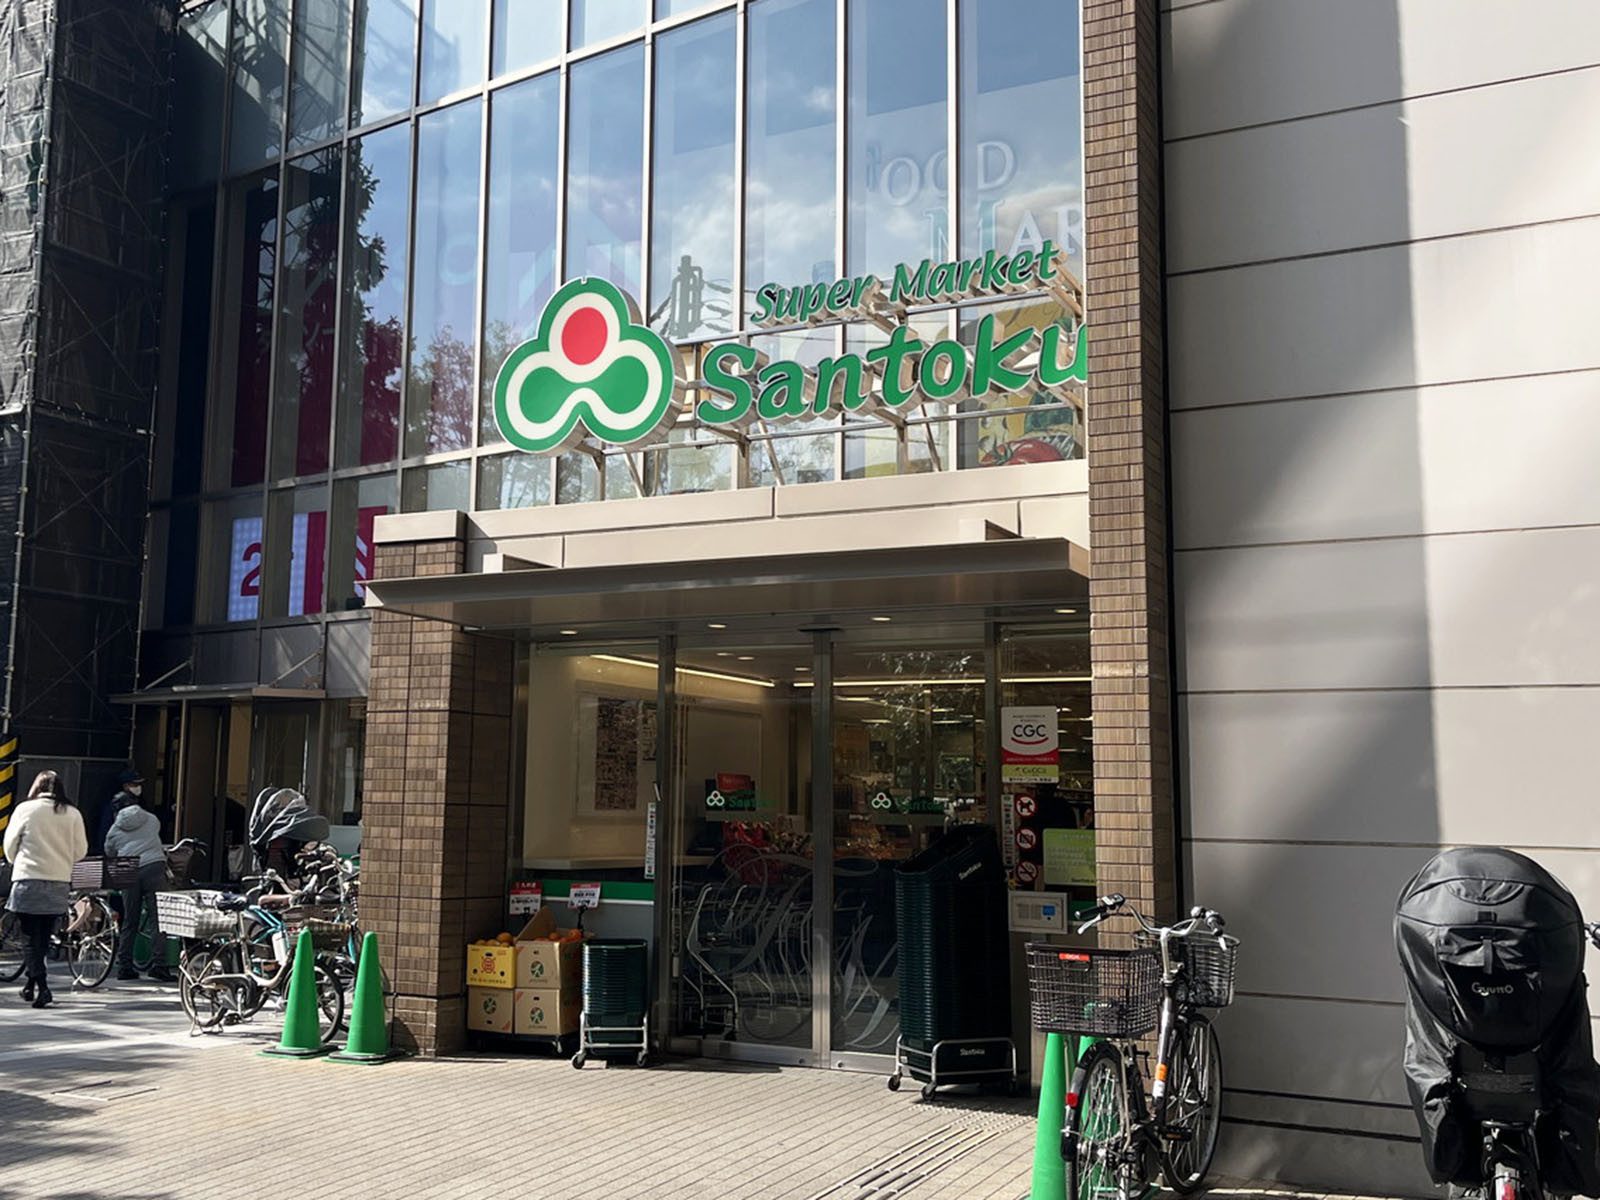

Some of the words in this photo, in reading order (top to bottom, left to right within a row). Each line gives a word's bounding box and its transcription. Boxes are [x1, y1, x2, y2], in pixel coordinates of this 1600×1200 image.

[751, 273, 873, 323] Super
[890, 239, 1057, 304] Market
[699, 314, 1087, 426] Santoku
[1013, 724, 1046, 738] CGC
